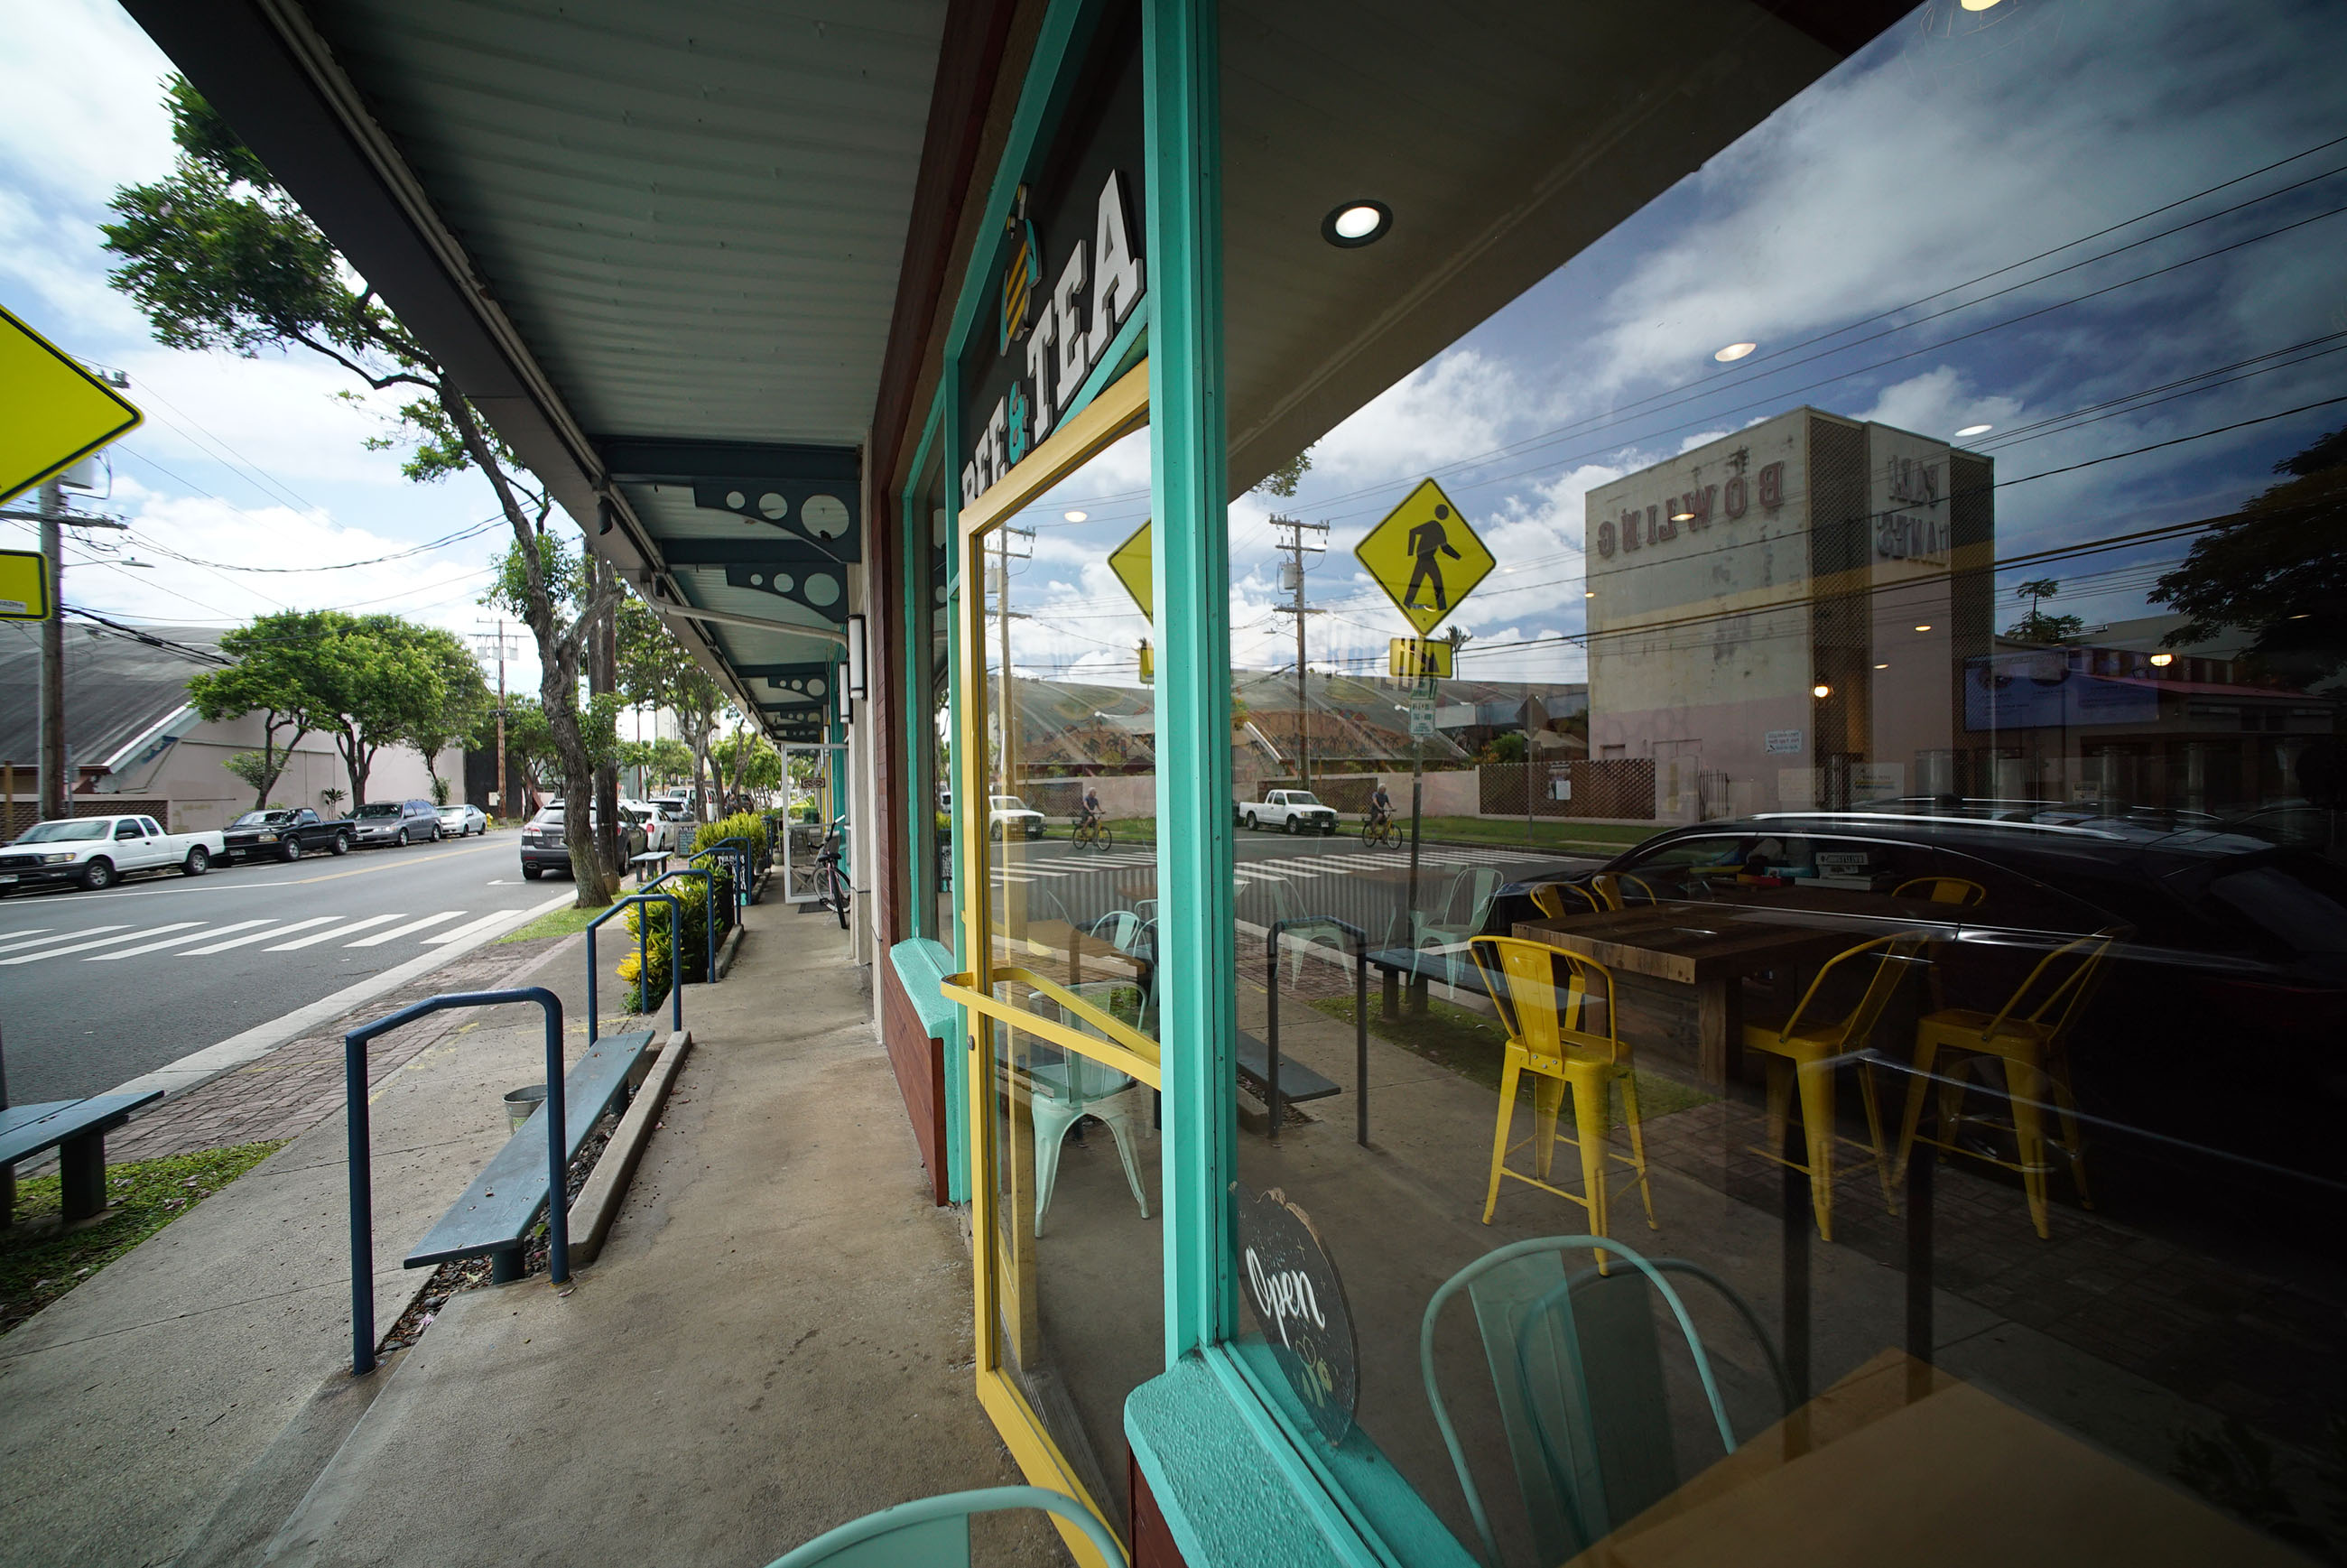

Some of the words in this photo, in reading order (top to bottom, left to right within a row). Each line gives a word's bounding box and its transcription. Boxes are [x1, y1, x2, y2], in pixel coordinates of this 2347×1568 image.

[1008, 378, 1030, 465] &
[1027, 169, 1145, 445] TEA
[1246, 1246, 1325, 1351] Open
